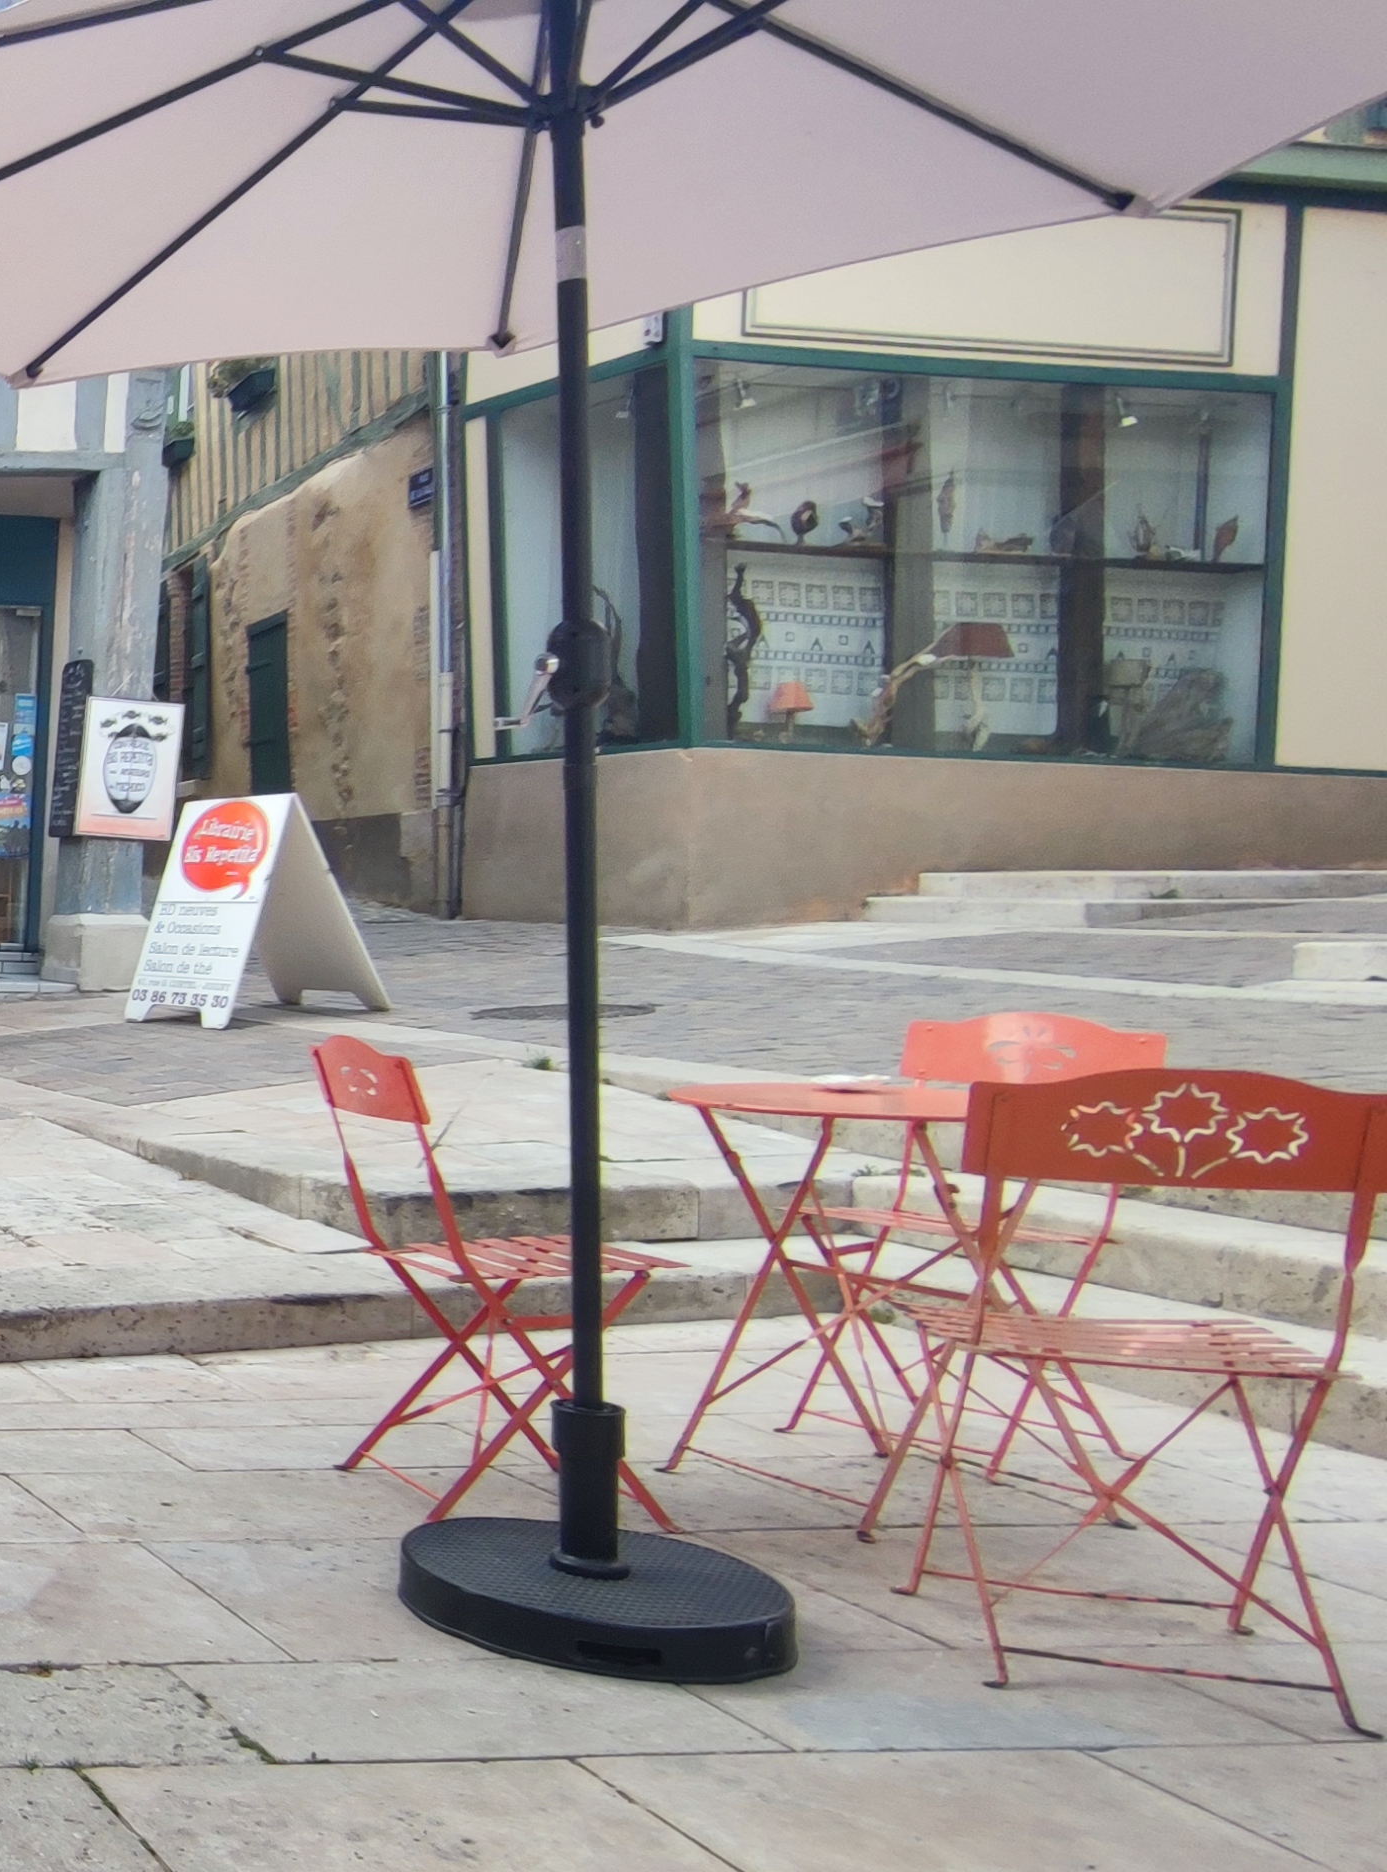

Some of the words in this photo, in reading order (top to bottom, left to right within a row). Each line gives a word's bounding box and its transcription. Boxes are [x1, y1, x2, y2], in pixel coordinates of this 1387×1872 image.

[193, 817, 255, 842] Librairie
[204, 844, 260, 866] Repetita
[159, 903, 176, 916] BD
[178, 906, 218, 917] neuves
[154, 921, 164, 934] &
[167, 921, 221, 935] Occasions
[148, 941, 179, 956] Salon
[181, 943, 196, 956] de
[198, 943, 240, 957] lecture
[143, 959, 174, 973] Salon
[176, 960, 191, 973] de
[193, 960, 213, 974] thé
[131, 988, 148, 1001] 03
[150, 990, 167, 1003] 86
[171, 992, 188, 1005] 73
[190, 993, 209, 1006] 35
[210, 995, 230, 1009] 30
